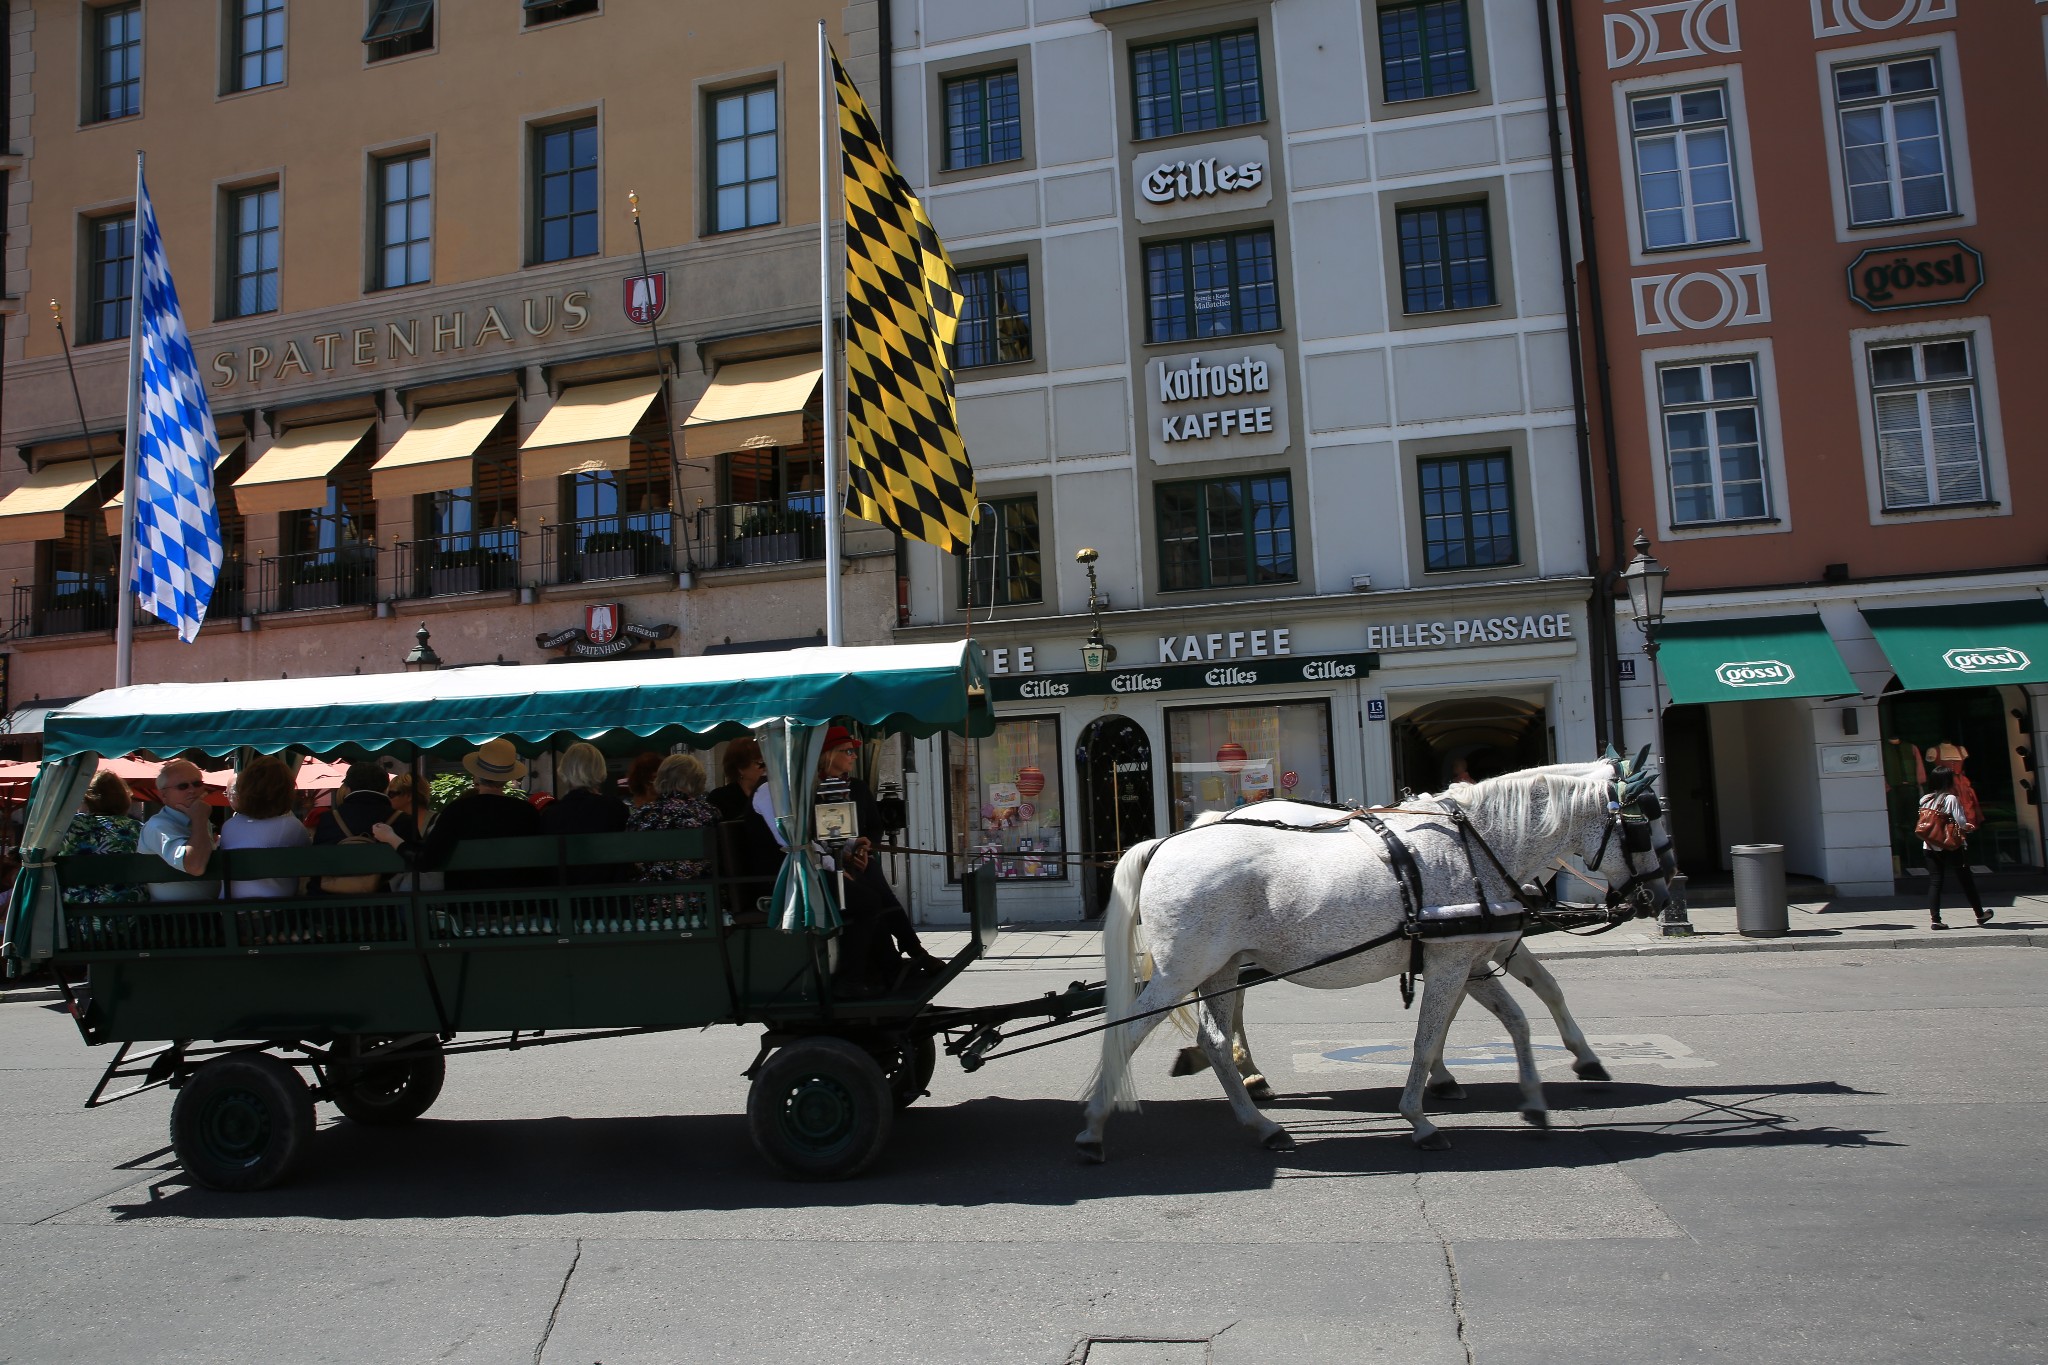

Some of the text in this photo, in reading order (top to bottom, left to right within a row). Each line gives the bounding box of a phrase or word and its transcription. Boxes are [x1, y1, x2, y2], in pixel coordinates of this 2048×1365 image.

[1141, 157, 1263, 203] Eilles
[1864, 253, 1965, 301] gössl
[211, 290, 591, 388] SPATENHAUS
[1158, 356, 1269, 402] kofrosta
[1161, 406, 1273, 443] KAFFEE
[627, 625, 659, 638] RESTAURANT
[1367, 613, 1572, 649] EILLES PASSAGE
[576, 640, 626, 656] SPATENHAUS
[1159, 628, 1291, 663] KAFFEE
[981, 646, 1035, 674] EE
[1302, 660, 1356, 680] Eilles
[1621, 661, 1632, 672] 14
[1954, 651, 2018, 669] gössl
[1111, 673, 1162, 693] Eilles
[1205, 667, 1258, 686] Eilles
[1726, 665, 1784, 683] gössl
[1019, 679, 1070, 698] Eilles
[1370, 701, 1383, 711] 13
